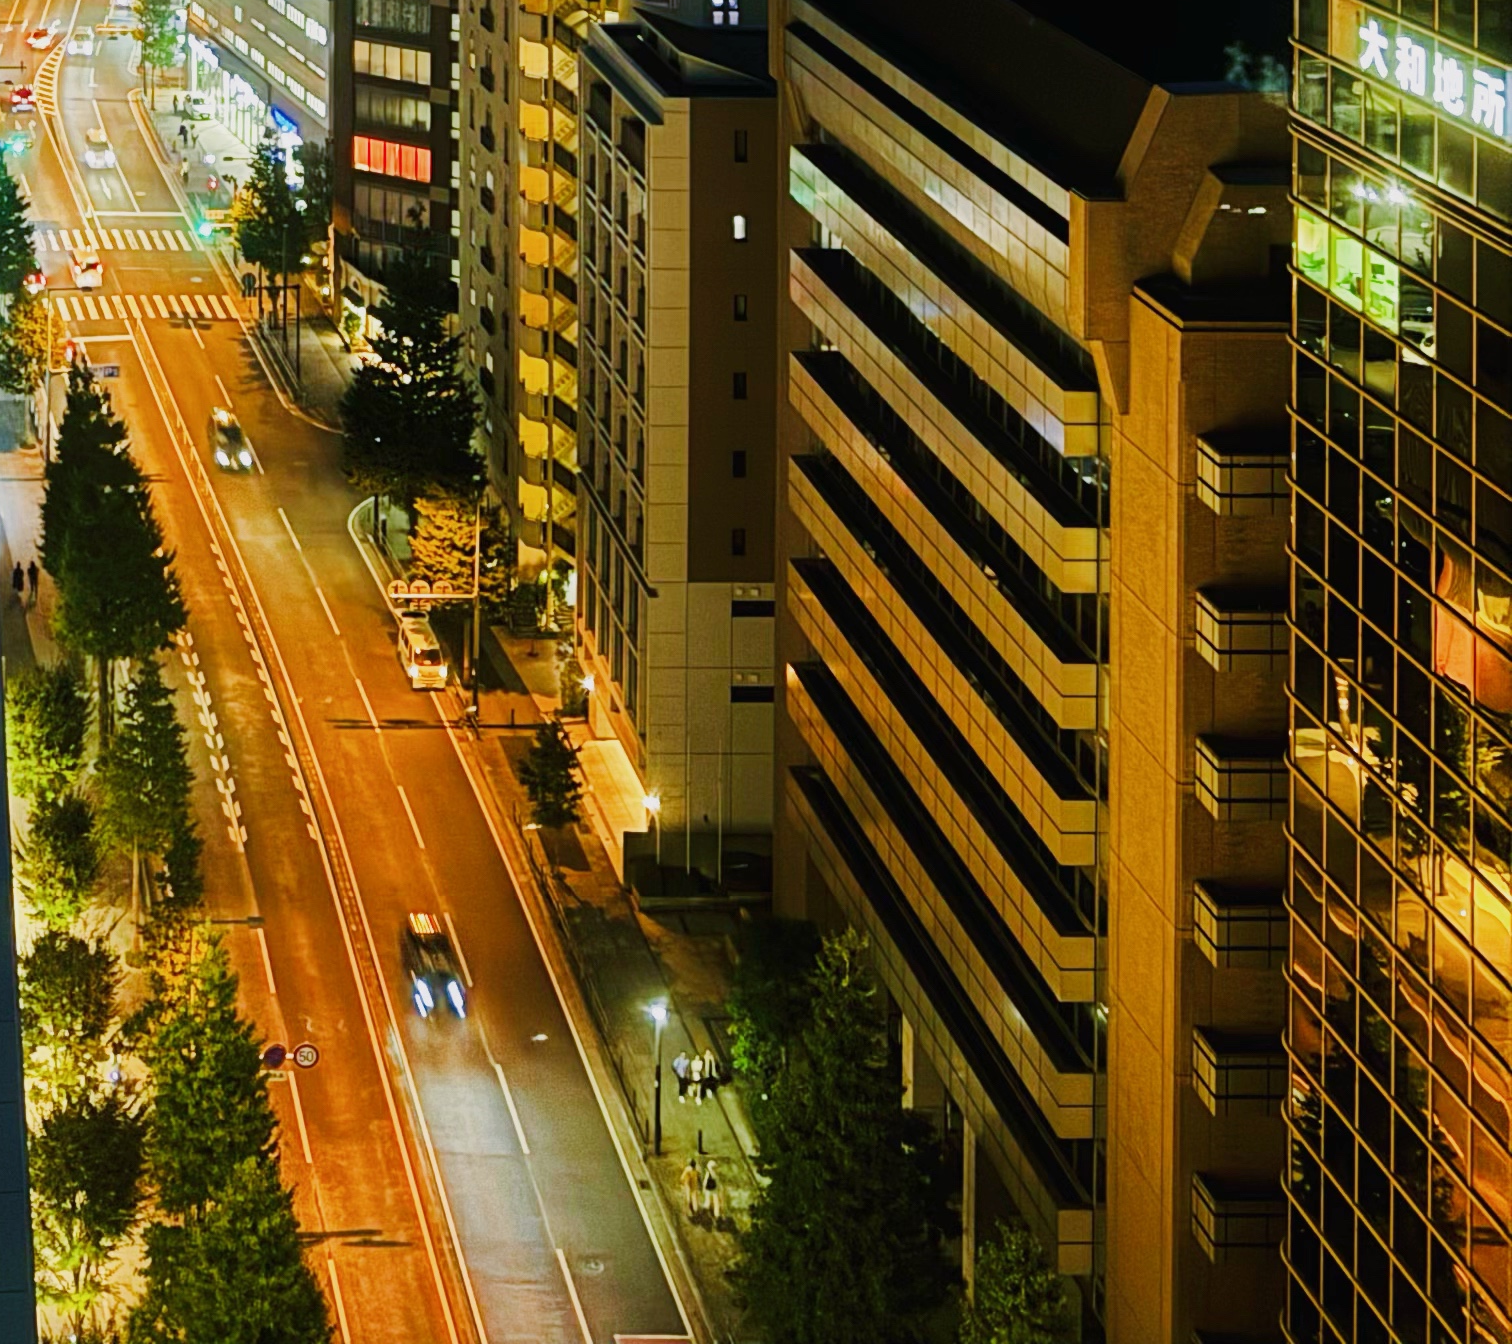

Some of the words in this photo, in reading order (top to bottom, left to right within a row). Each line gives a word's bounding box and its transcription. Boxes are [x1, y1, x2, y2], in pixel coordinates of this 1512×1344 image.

[1359, 18, 1505, 136] 大和地所
[299, 1051, 314, 1062] 50
